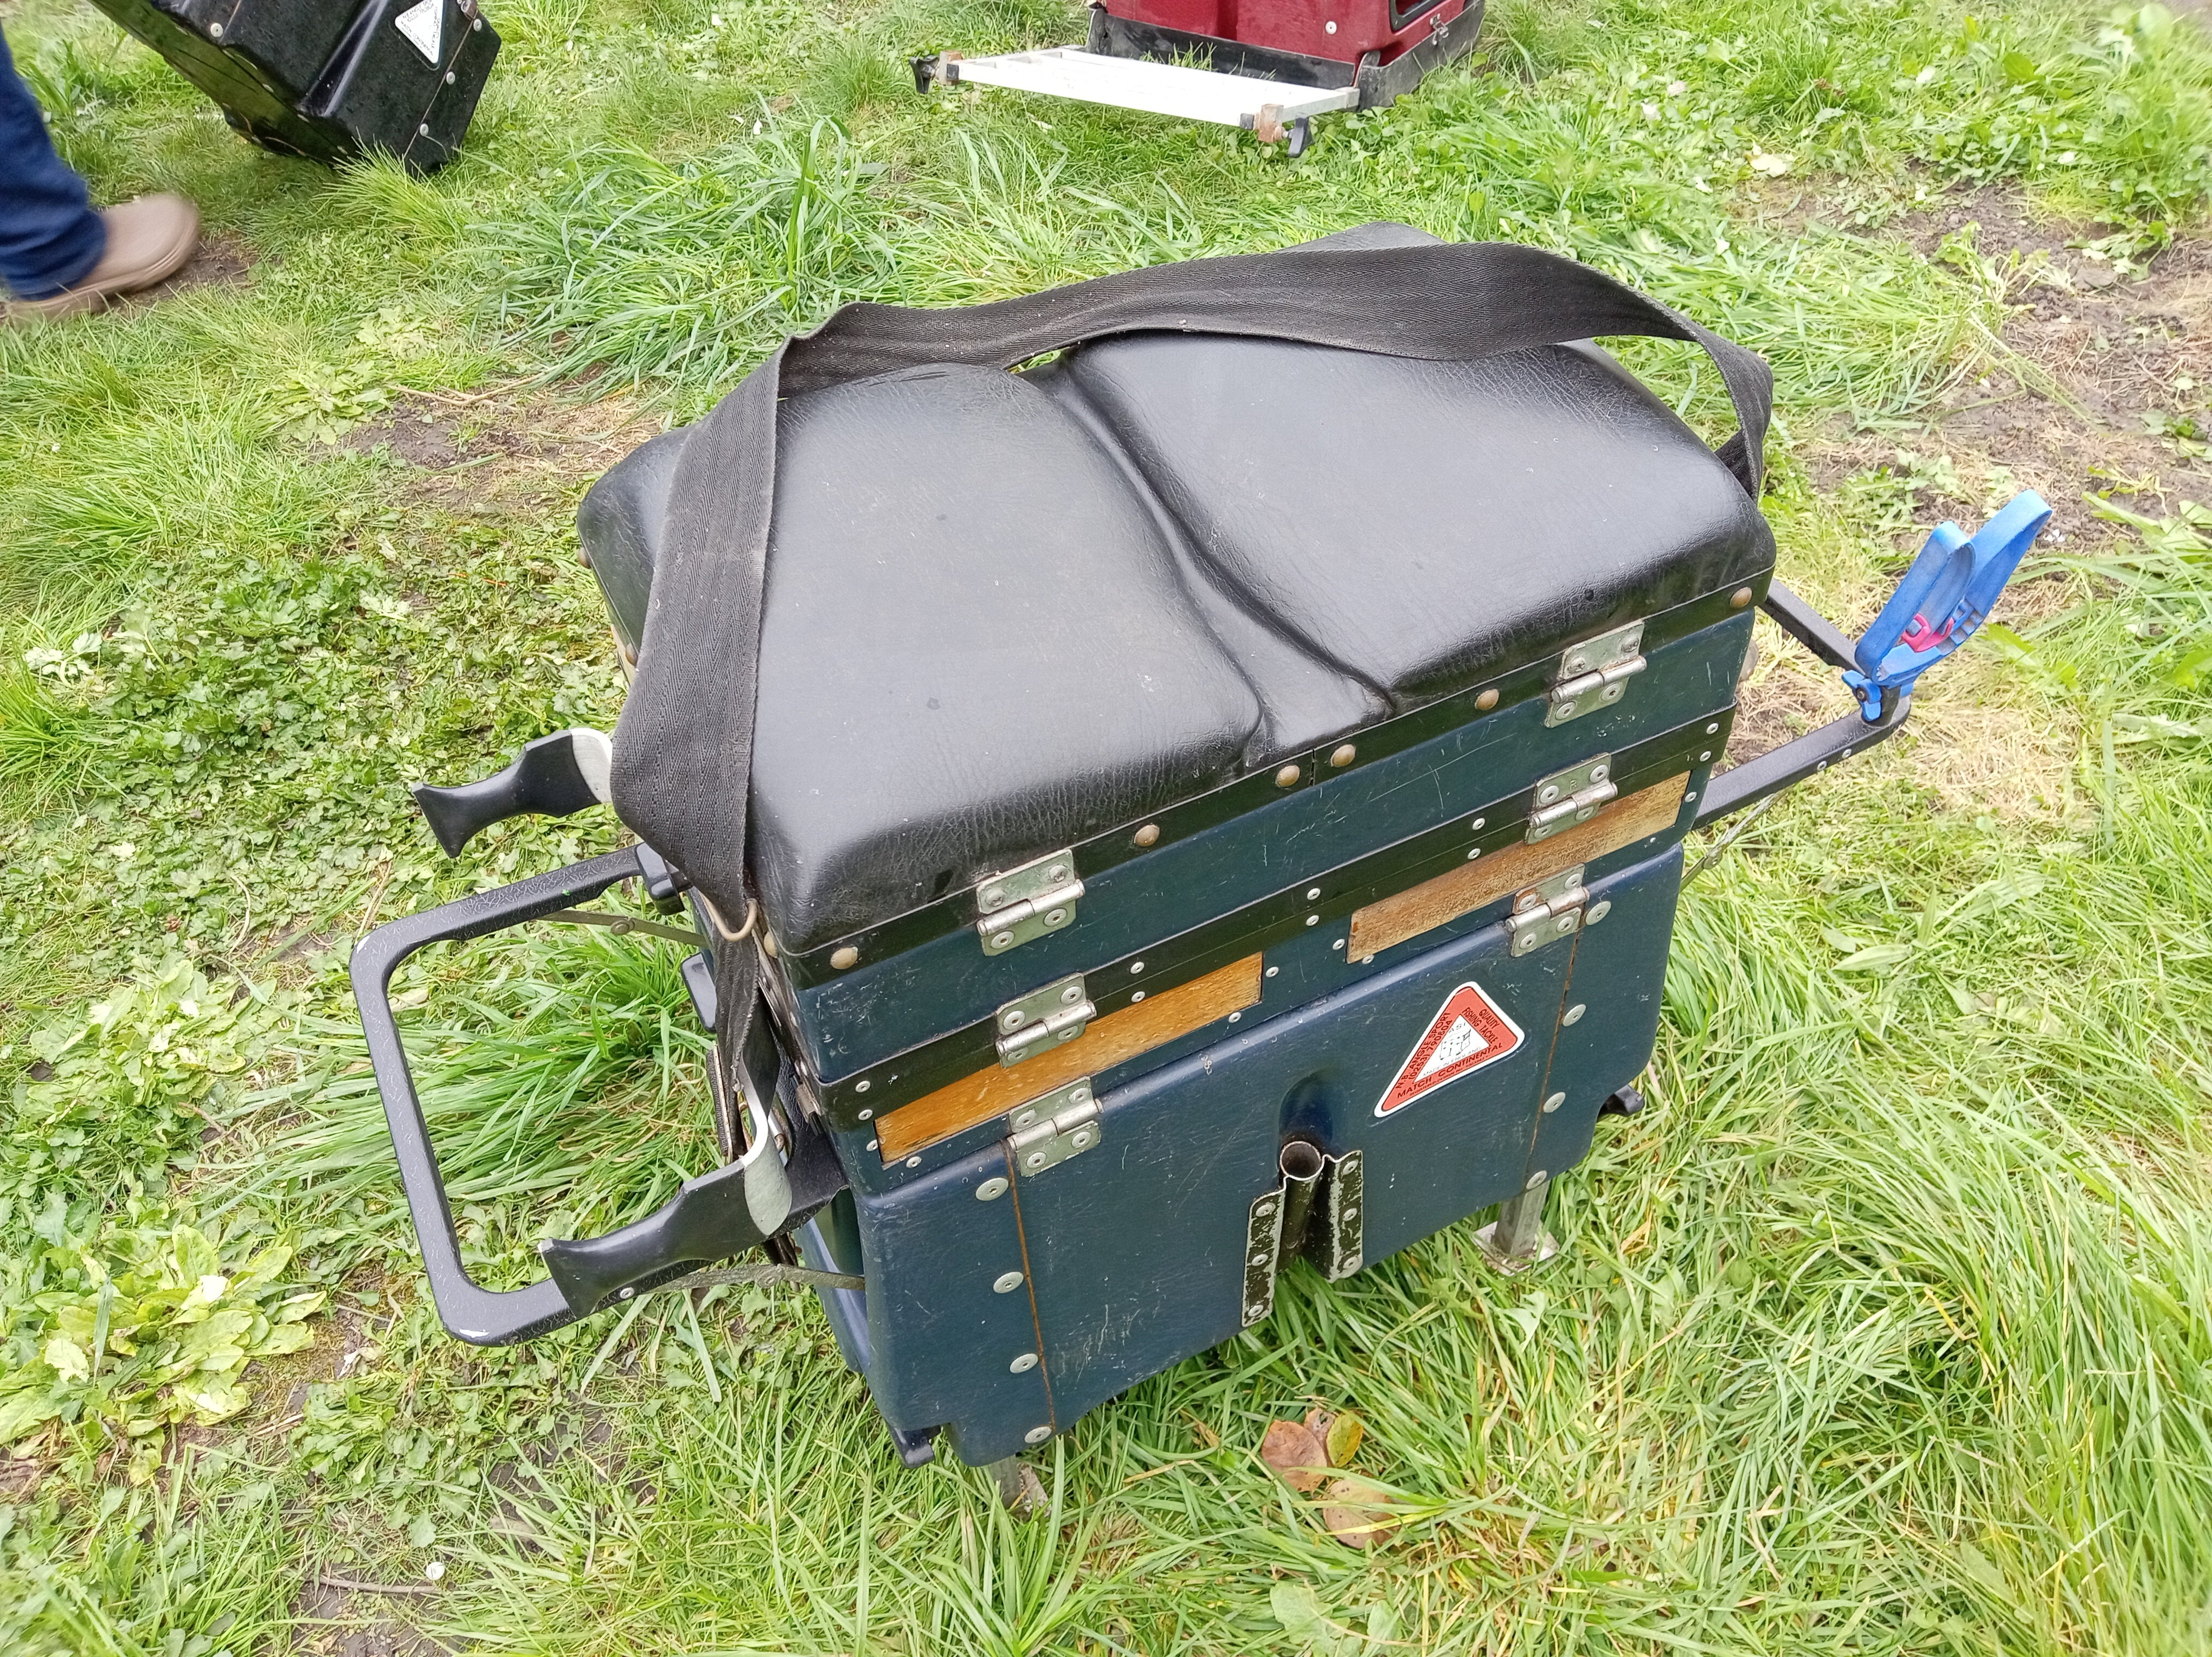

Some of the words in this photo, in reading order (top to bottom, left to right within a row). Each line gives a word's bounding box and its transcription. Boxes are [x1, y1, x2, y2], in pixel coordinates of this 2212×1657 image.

[1409, 1041, 1430, 1069] ANGLE
[1429, 1012, 1451, 1039] SPORT
[1462, 1007, 1482, 1026] FISHING
[1479, 1025, 1498, 1044] TACKLE
[1479, 1009, 1500, 1029] QUALITY
[1397, 1076, 1432, 1099] MATCH
[1438, 1042, 1503, 1077] CONTINENTAL
[1409, 1054, 1430, 1080] (0253)
[1427, 1019, 1452, 1051] 790804
